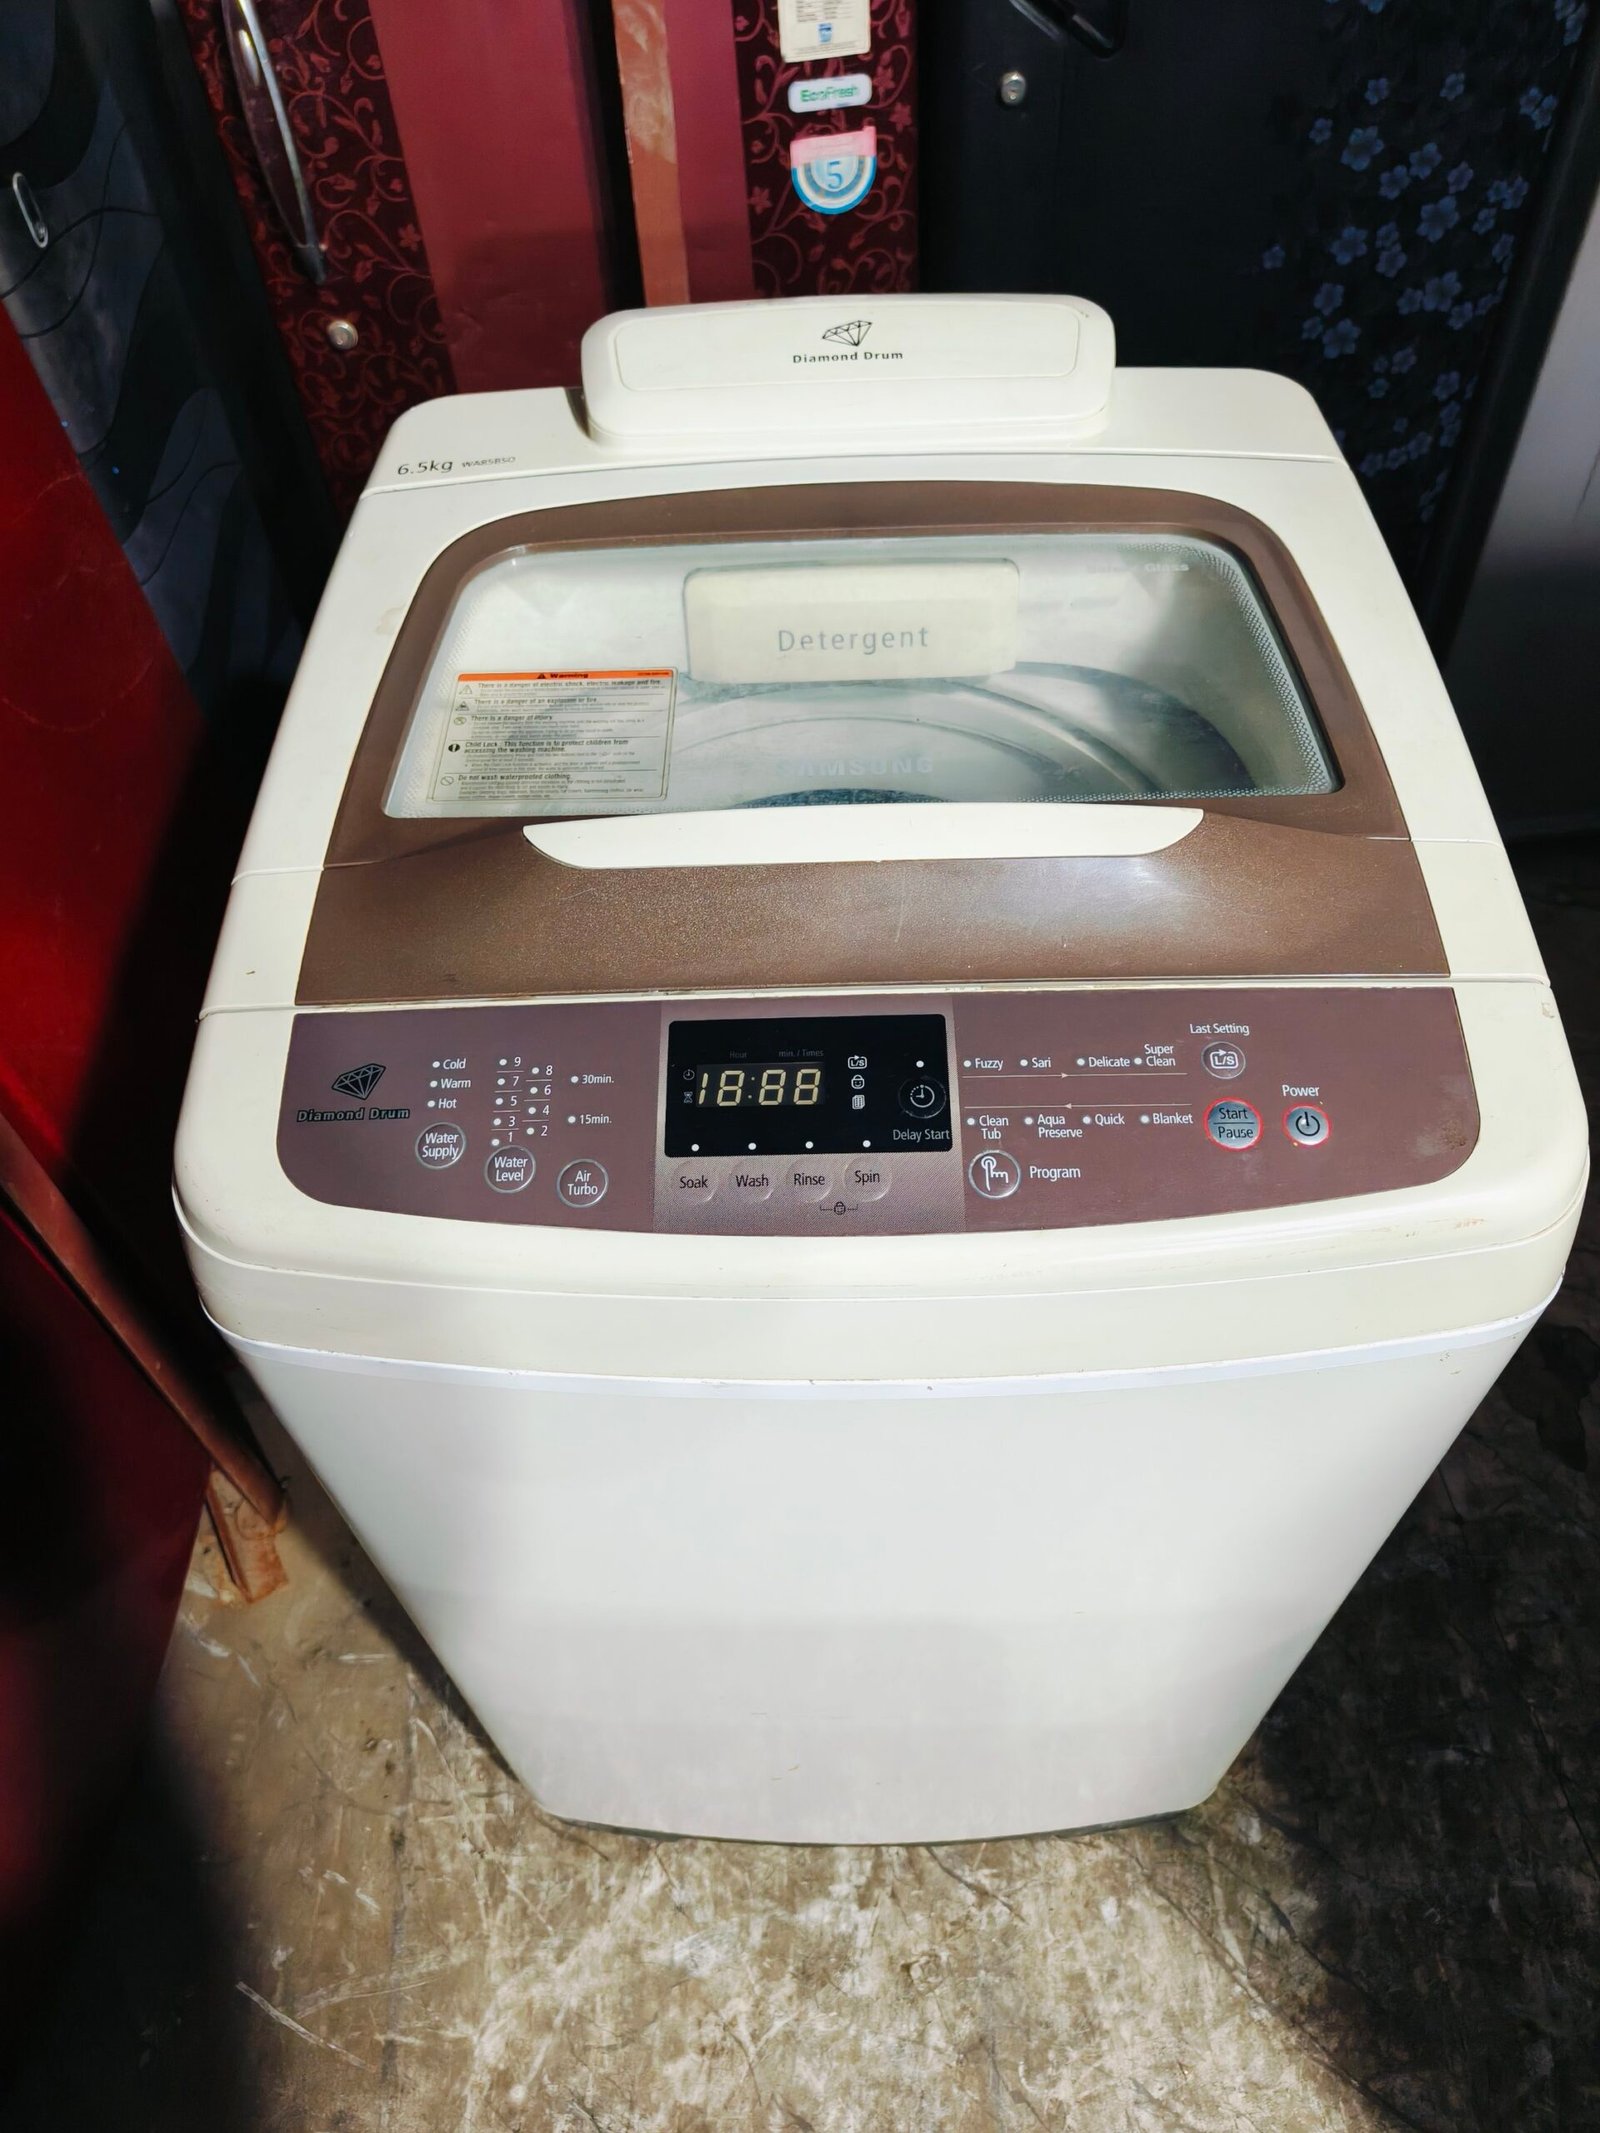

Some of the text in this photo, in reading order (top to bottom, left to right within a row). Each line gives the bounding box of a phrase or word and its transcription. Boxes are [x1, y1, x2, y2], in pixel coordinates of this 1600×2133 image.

[827, 160, 842, 189] 5
[793, 351, 903, 363] Diamond Drum
[397, 460, 453, 475] 6.5kg
[778, 627, 929, 656] Detergent
[1190, 1023, 1250, 1037] Last Setting
[802, 1048, 824, 1058] Times
[1144, 1044, 1174, 1056] Super
[443, 1058, 466, 1070] Cold
[513, 1057, 521, 1067] 9
[975, 1058, 1003, 1071] Fuzzy
[1032, 1057, 1052, 1068] Sari
[1088, 1056, 1130, 1068] Delicate
[1146, 1055, 1176, 1067] Clean
[545, 1065, 553, 1076] 8
[440, 1078, 471, 1089] Warm
[512, 1076, 519, 1087] 7
[581, 1073, 615, 1085] 30min.
[544, 1085, 551, 1095] 6
[1282, 1084, 1320, 1097] Power
[438, 1098, 457, 1109] Hot
[510, 1096, 518, 1107] 5
[297, 1107, 411, 1122] Diamond Drum
[542, 1105, 550, 1116] 4
[1218, 1107, 1248, 1120] Start
[508, 1116, 516, 1127] 3
[579, 1114, 612, 1125] 15min.
[979, 1115, 1009, 1127] Clean
[1037, 1114, 1066, 1128] Aqua
[1095, 1113, 1125, 1126] Quick
[1153, 1113, 1193, 1125] Blanket
[507, 1132, 513, 1142] 1
[540, 1126, 548, 1136] 2
[892, 1129, 950, 1143] Delay Start
[981, 1128, 1001, 1140] Tub
[1038, 1127, 1083, 1138] Preserve
[1218, 1126, 1254, 1139] Pause
[425, 1133, 459, 1145] Water
[422, 1145, 459, 1160] Supply
[494, 1156, 528, 1169] Water
[496, 1169, 524, 1182] Level
[575, 1171, 591, 1182] Air
[855, 1170, 881, 1185] Spin
[1029, 1166, 1081, 1180] Program
[679, 1175, 708, 1189] Soak
[735, 1174, 769, 1187] Wash
[793, 1173, 825, 1186] Rinse
[567, 1183, 598, 1196] Turbo
